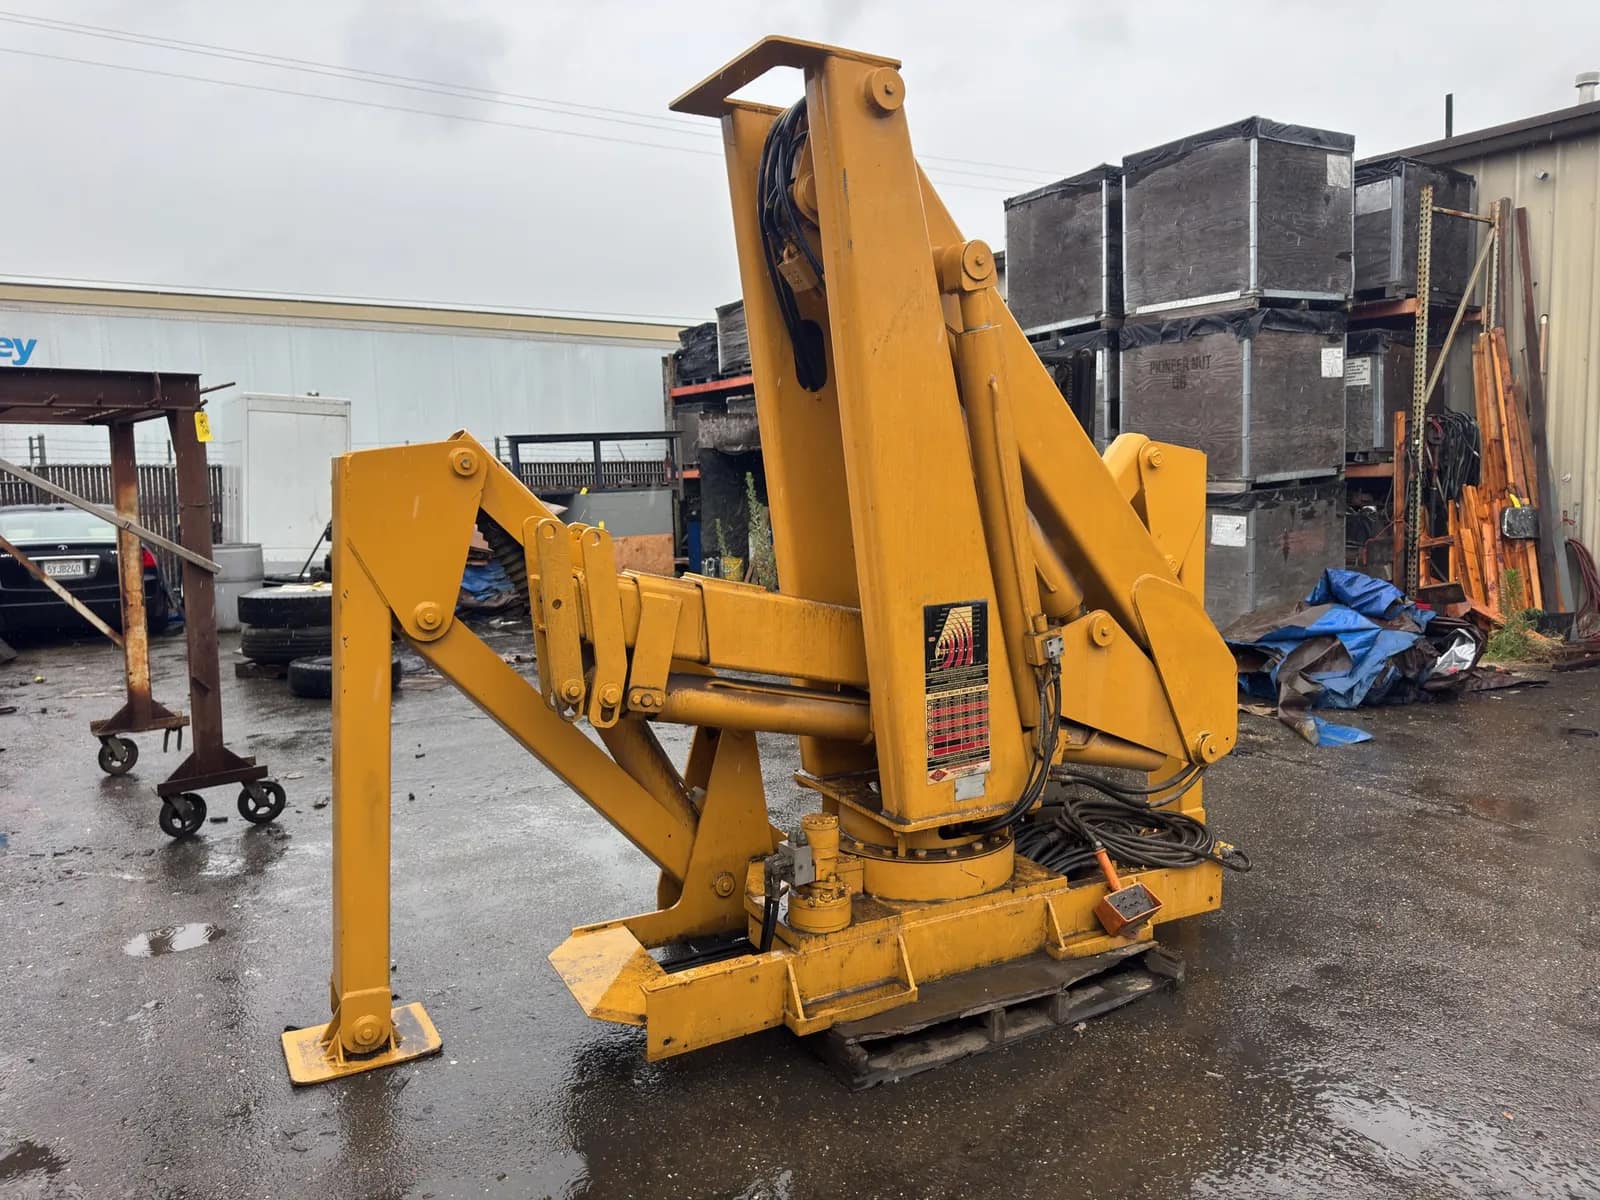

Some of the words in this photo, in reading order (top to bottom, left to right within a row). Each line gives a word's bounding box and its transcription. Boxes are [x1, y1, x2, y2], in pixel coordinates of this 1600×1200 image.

[0, 337, 37, 366] ey
[1150, 356, 1190, 375] PIONEER
[1191, 354, 1212, 370] NUT
